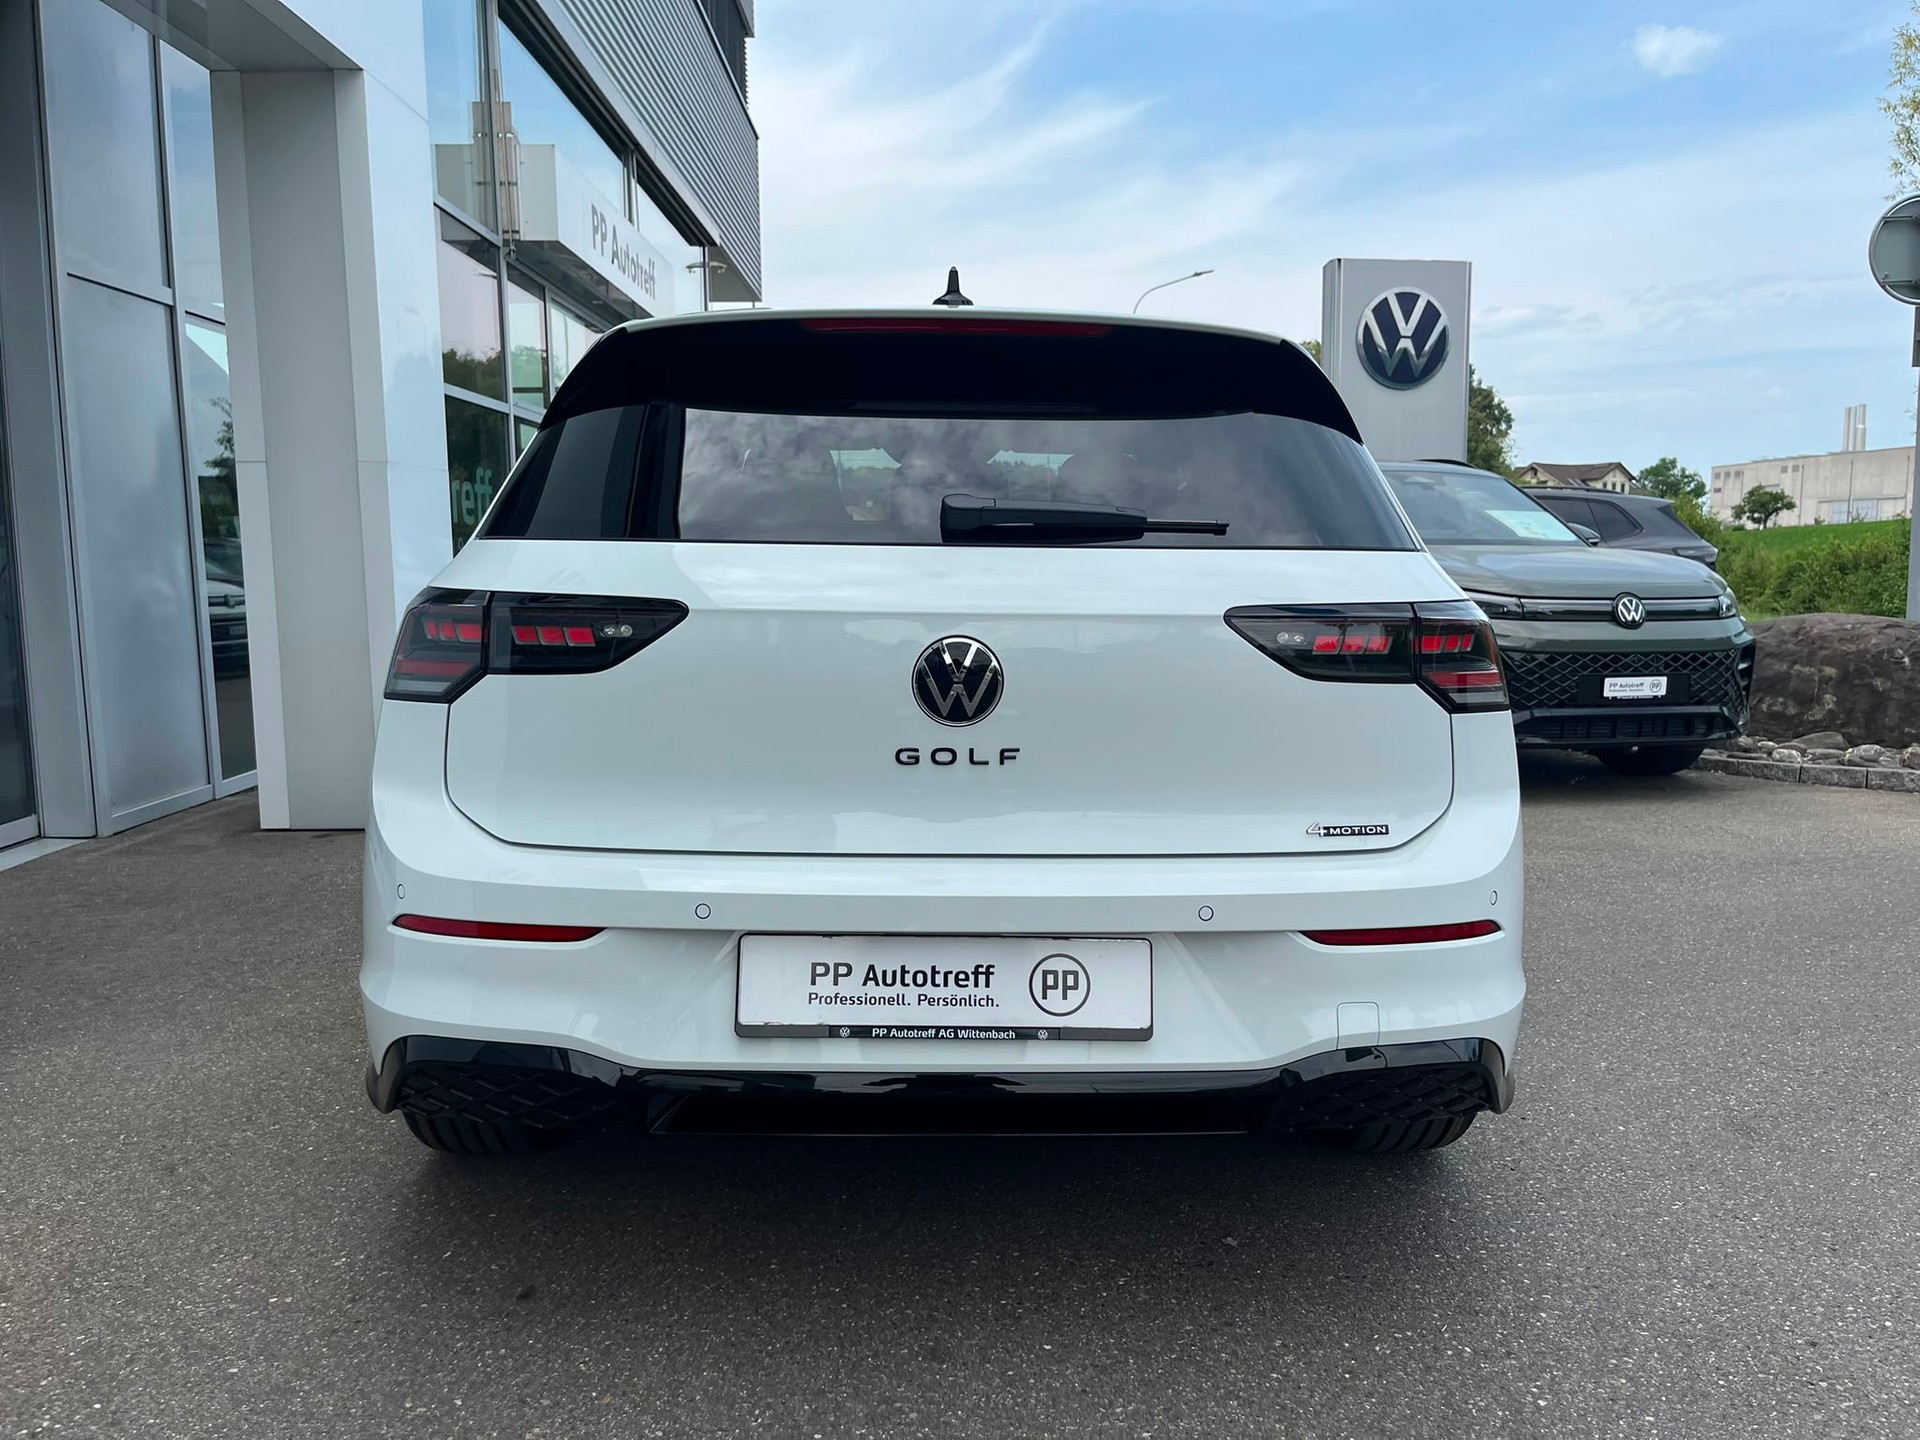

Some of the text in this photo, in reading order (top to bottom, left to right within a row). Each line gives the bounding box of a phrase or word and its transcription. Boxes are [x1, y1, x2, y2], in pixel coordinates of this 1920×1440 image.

[591, 203, 656, 300] PP Autotreff
[895, 747, 1021, 766] GOLF
[1306, 821, 1388, 837] 4MOTION
[810, 962, 996, 989] PP Autotreff
[1041, 969, 1080, 1001] PP
[808, 992, 1000, 1008] Professionell. Persönlich.
[872, 1027, 1016, 1040] PP Autotreff AG Wittenbach
